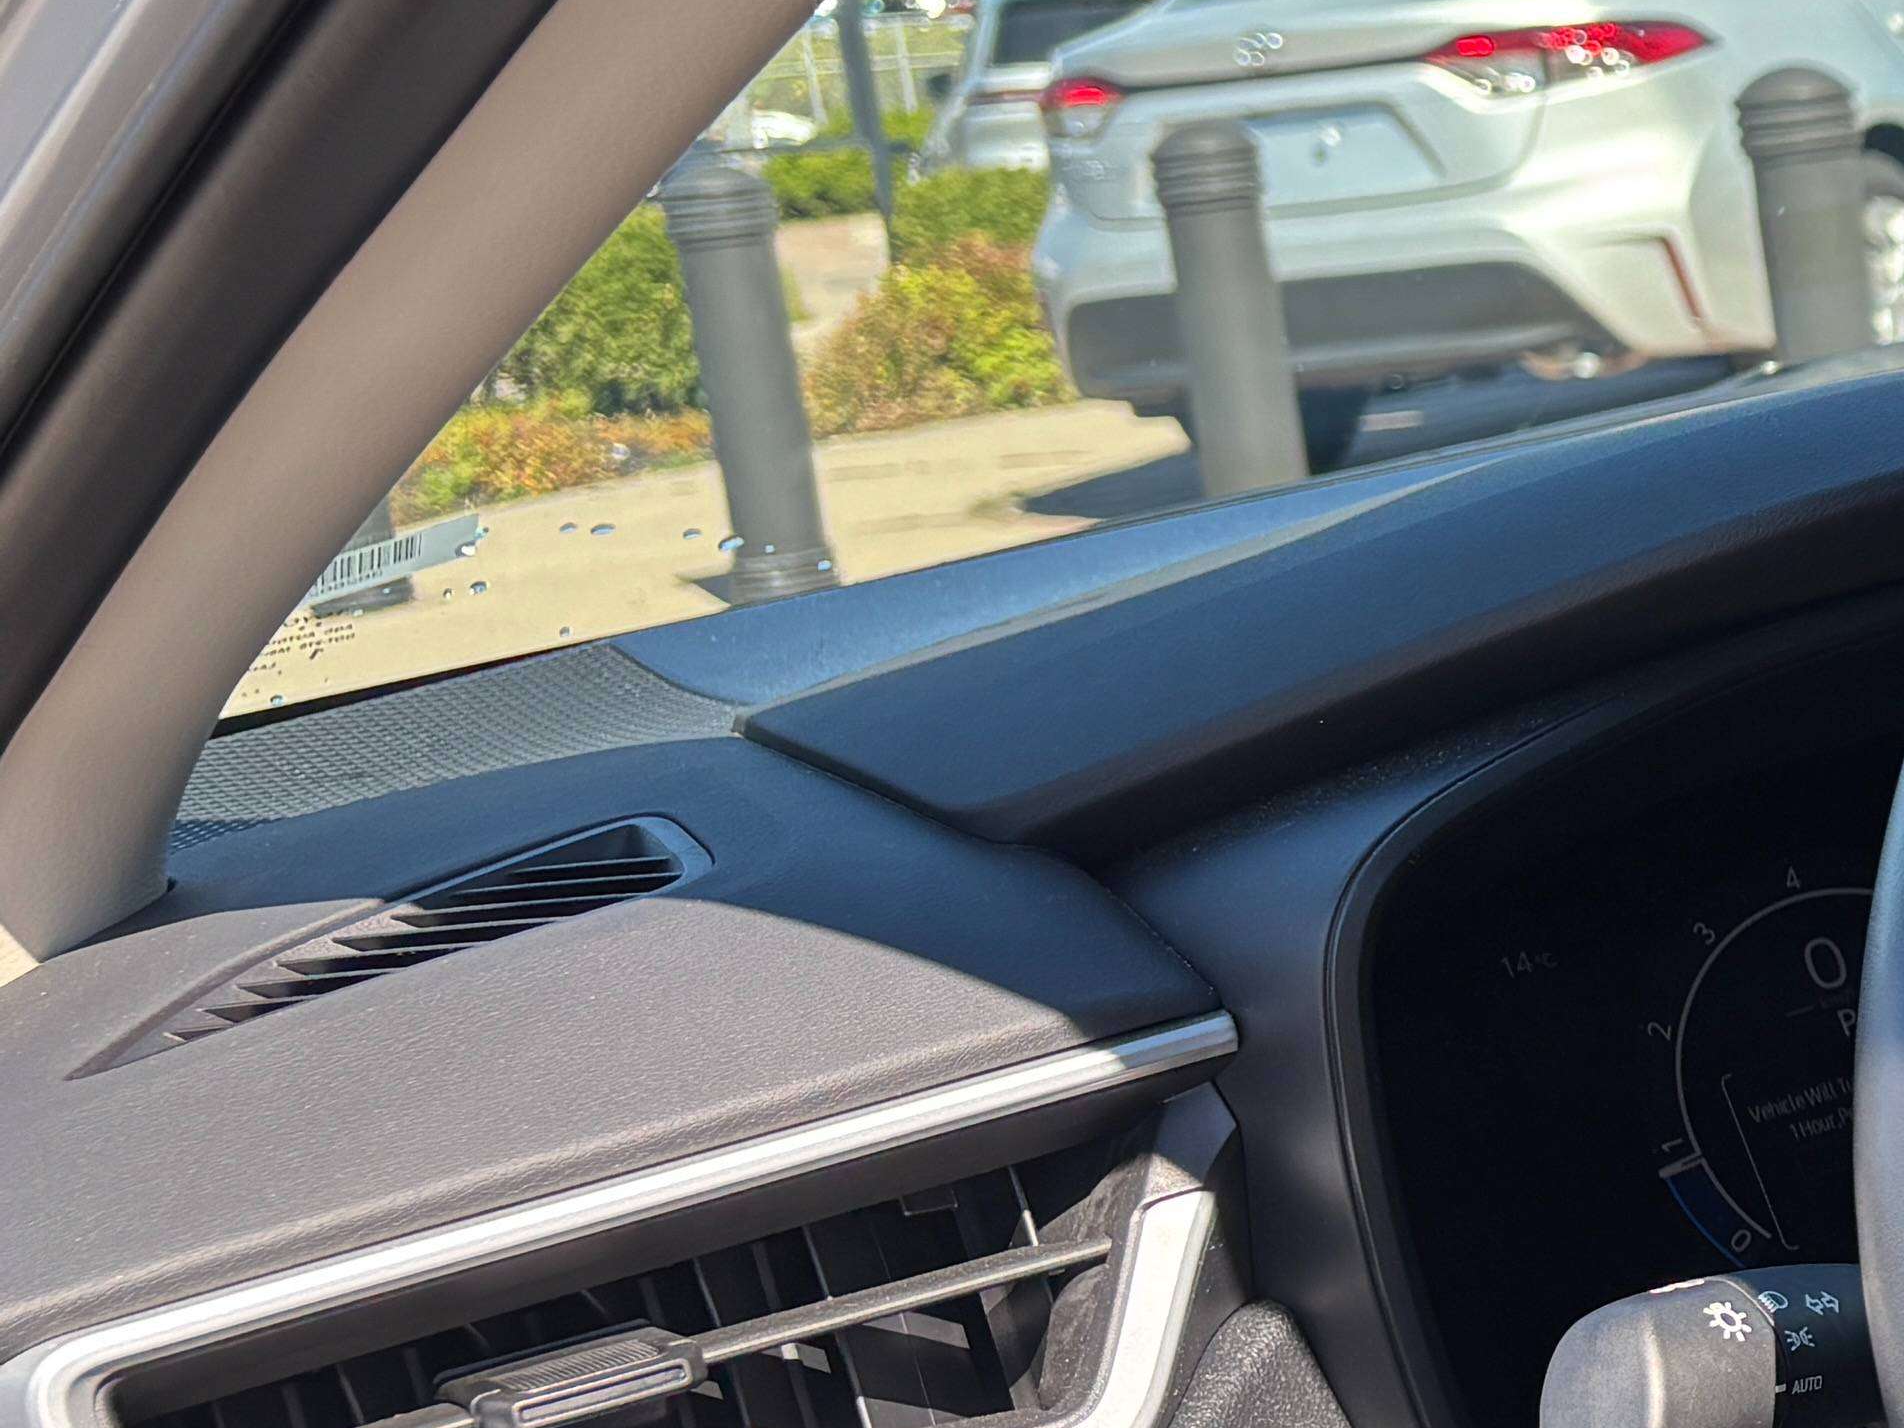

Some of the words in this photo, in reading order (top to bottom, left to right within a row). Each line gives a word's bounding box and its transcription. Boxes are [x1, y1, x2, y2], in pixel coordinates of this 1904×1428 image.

[1784, 864, 1802, 890] 4
[1692, 920, 1717, 946] 3
[1803, 936, 1848, 991] 0
[1646, 1020, 1673, 1042] 2
[1837, 1007, 1857, 1037] P
[1660, 1136, 1685, 1155] 1
[1729, 1228, 1755, 1254] 0
[1791, 1384, 1823, 1405] AUTO
